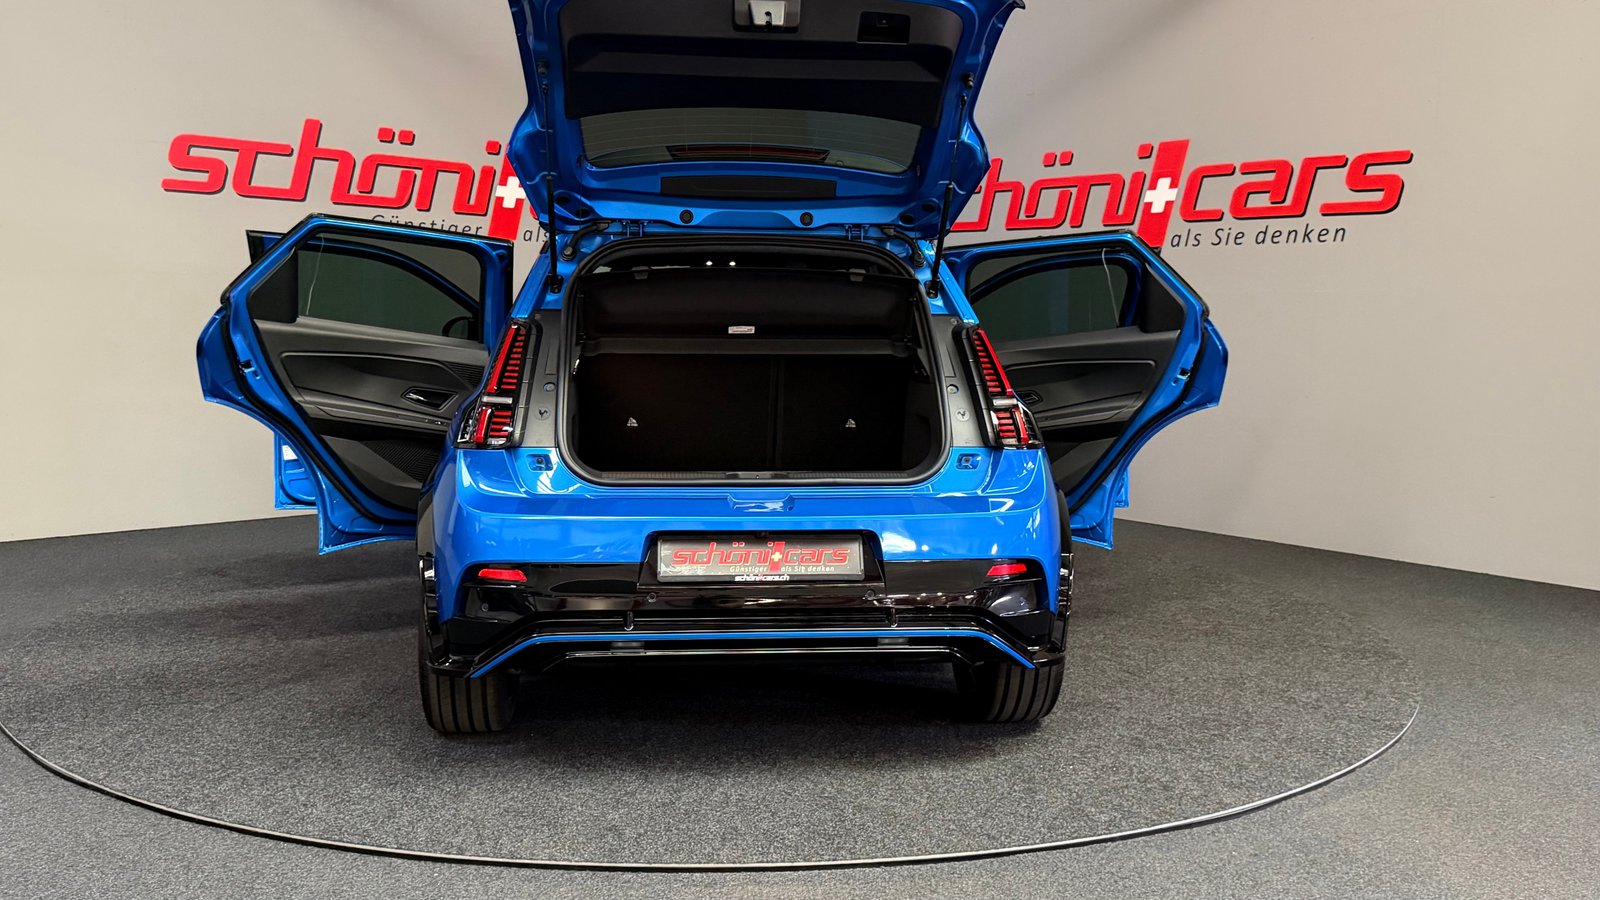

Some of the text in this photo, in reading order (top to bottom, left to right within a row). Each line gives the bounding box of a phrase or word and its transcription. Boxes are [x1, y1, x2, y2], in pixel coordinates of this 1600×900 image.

[1170, 223, 1347, 248] als Sie denken
